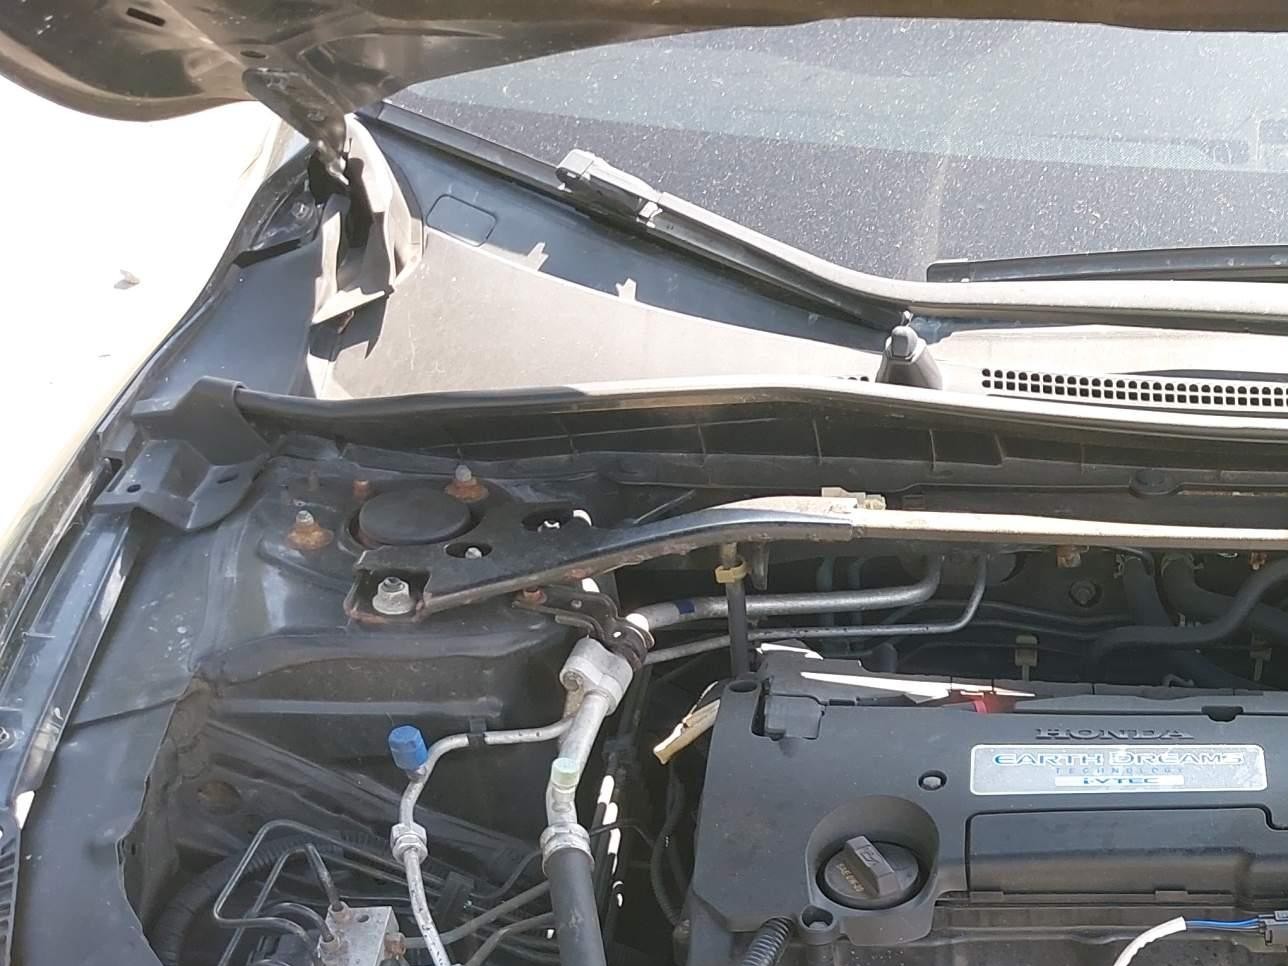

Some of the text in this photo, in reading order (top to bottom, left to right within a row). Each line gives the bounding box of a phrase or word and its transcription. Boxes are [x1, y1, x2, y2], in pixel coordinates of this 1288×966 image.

[1034, 728, 1195, 741] HONDA
[992, 751, 1245, 766] EARTH DREAMS
[1055, 767, 1185, 775] TECHNOLOGY
